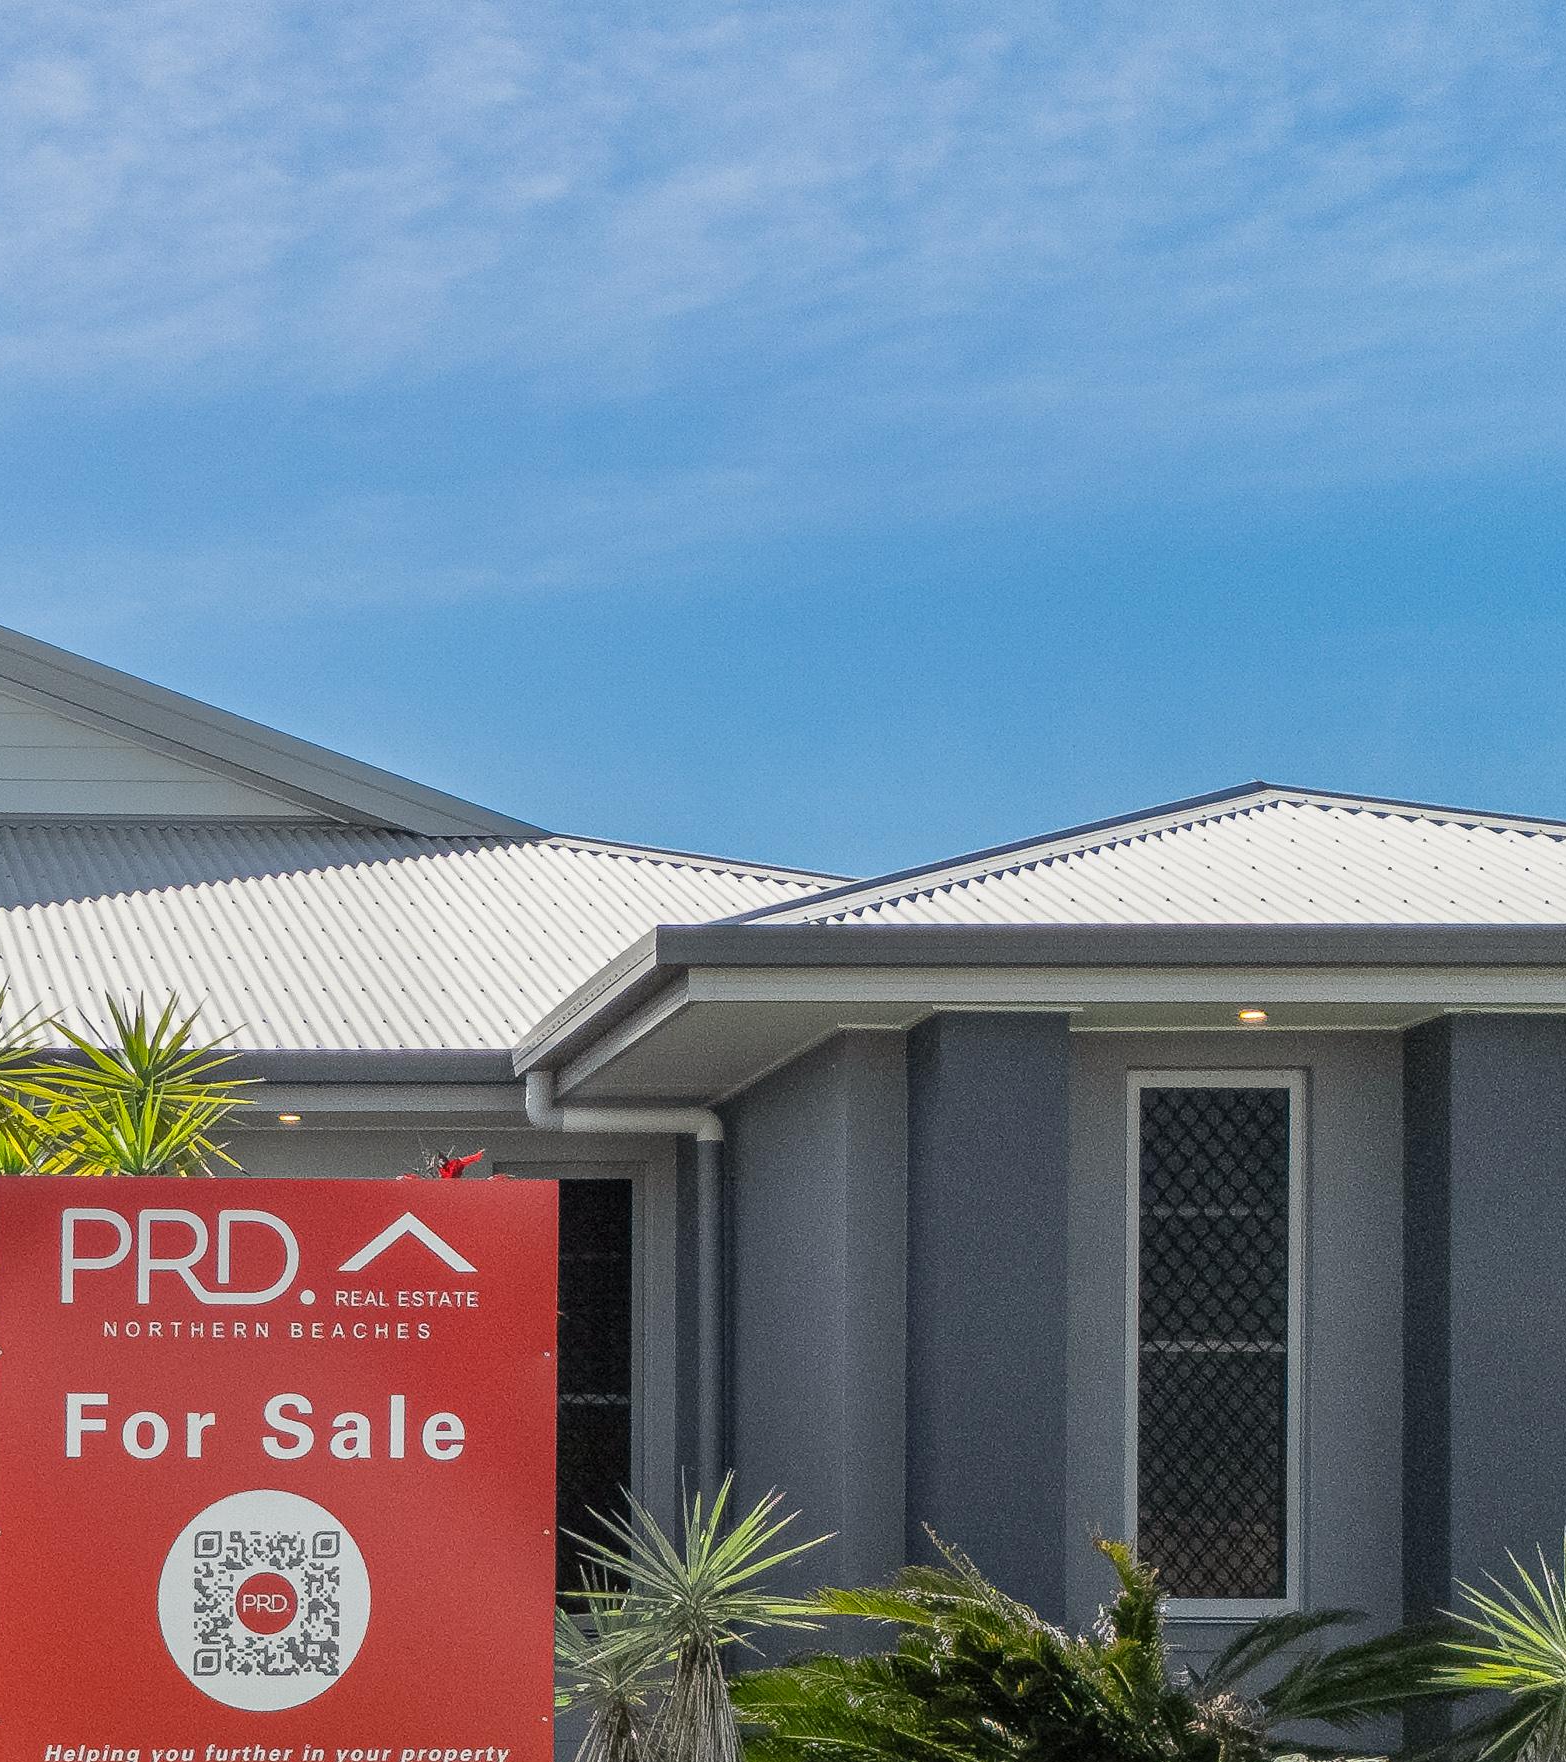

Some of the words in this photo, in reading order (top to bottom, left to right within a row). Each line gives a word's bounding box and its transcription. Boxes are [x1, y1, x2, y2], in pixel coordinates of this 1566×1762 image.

[60, 1208, 317, 1305] PRD.
[335, 1290, 390, 1308] REAL
[397, 1291, 479, 1308] ESTATE
[103, 1320, 270, 1339] NORTHERN
[290, 1322, 432, 1340] BEACHES
[65, 1393, 217, 1459] For
[262, 1393, 467, 1461] Sale
[205, 1744, 294, 1762] further
[302, 1744, 325, 1762] in
